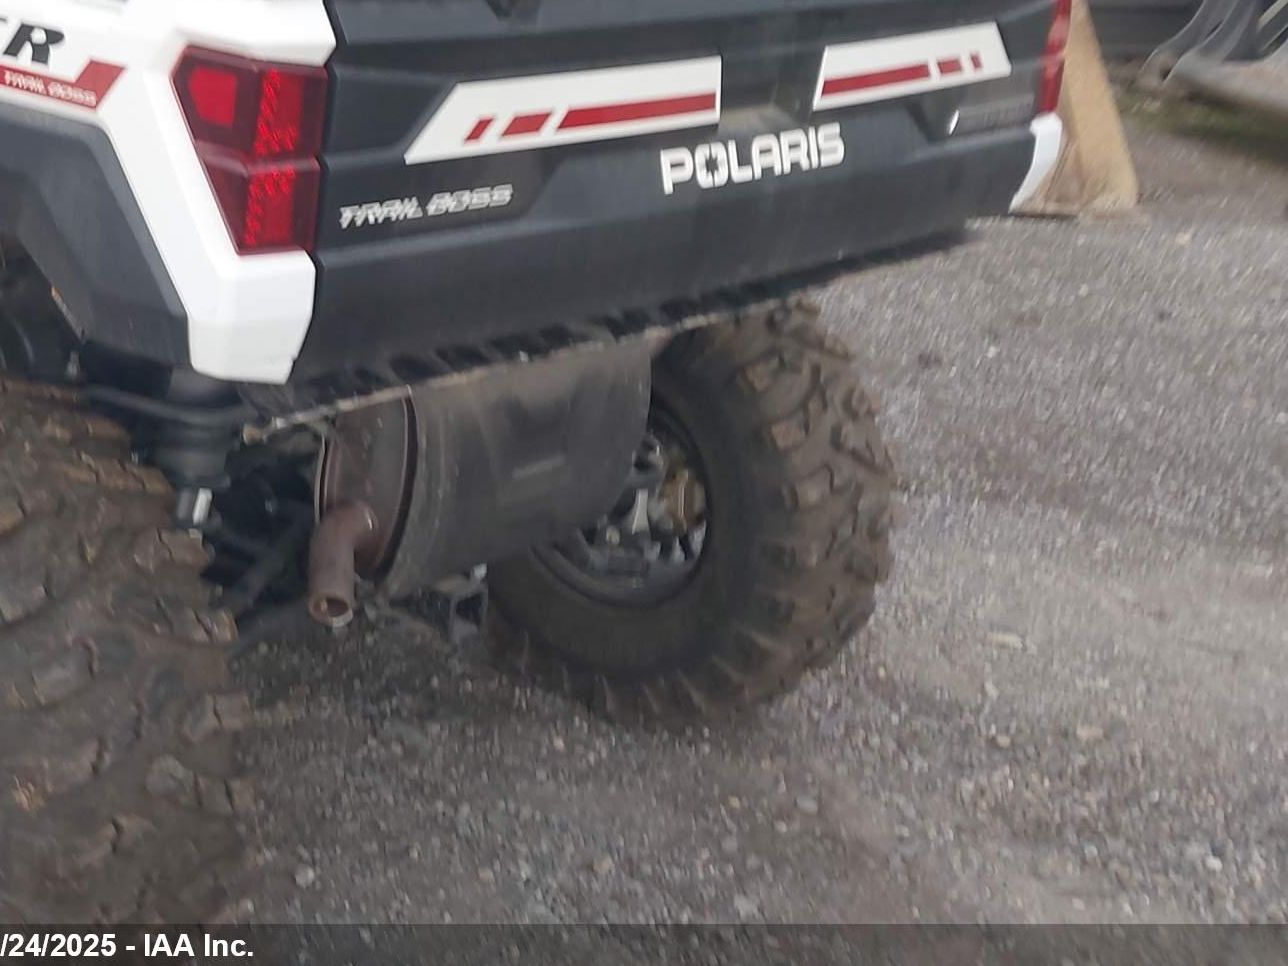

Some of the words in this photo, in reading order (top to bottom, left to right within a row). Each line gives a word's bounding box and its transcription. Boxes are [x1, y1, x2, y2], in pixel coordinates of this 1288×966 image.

[660, 122, 845, 195] POLARIS
[339, 196, 423, 229] TRAIL
[426, 183, 513, 216] BOSS
